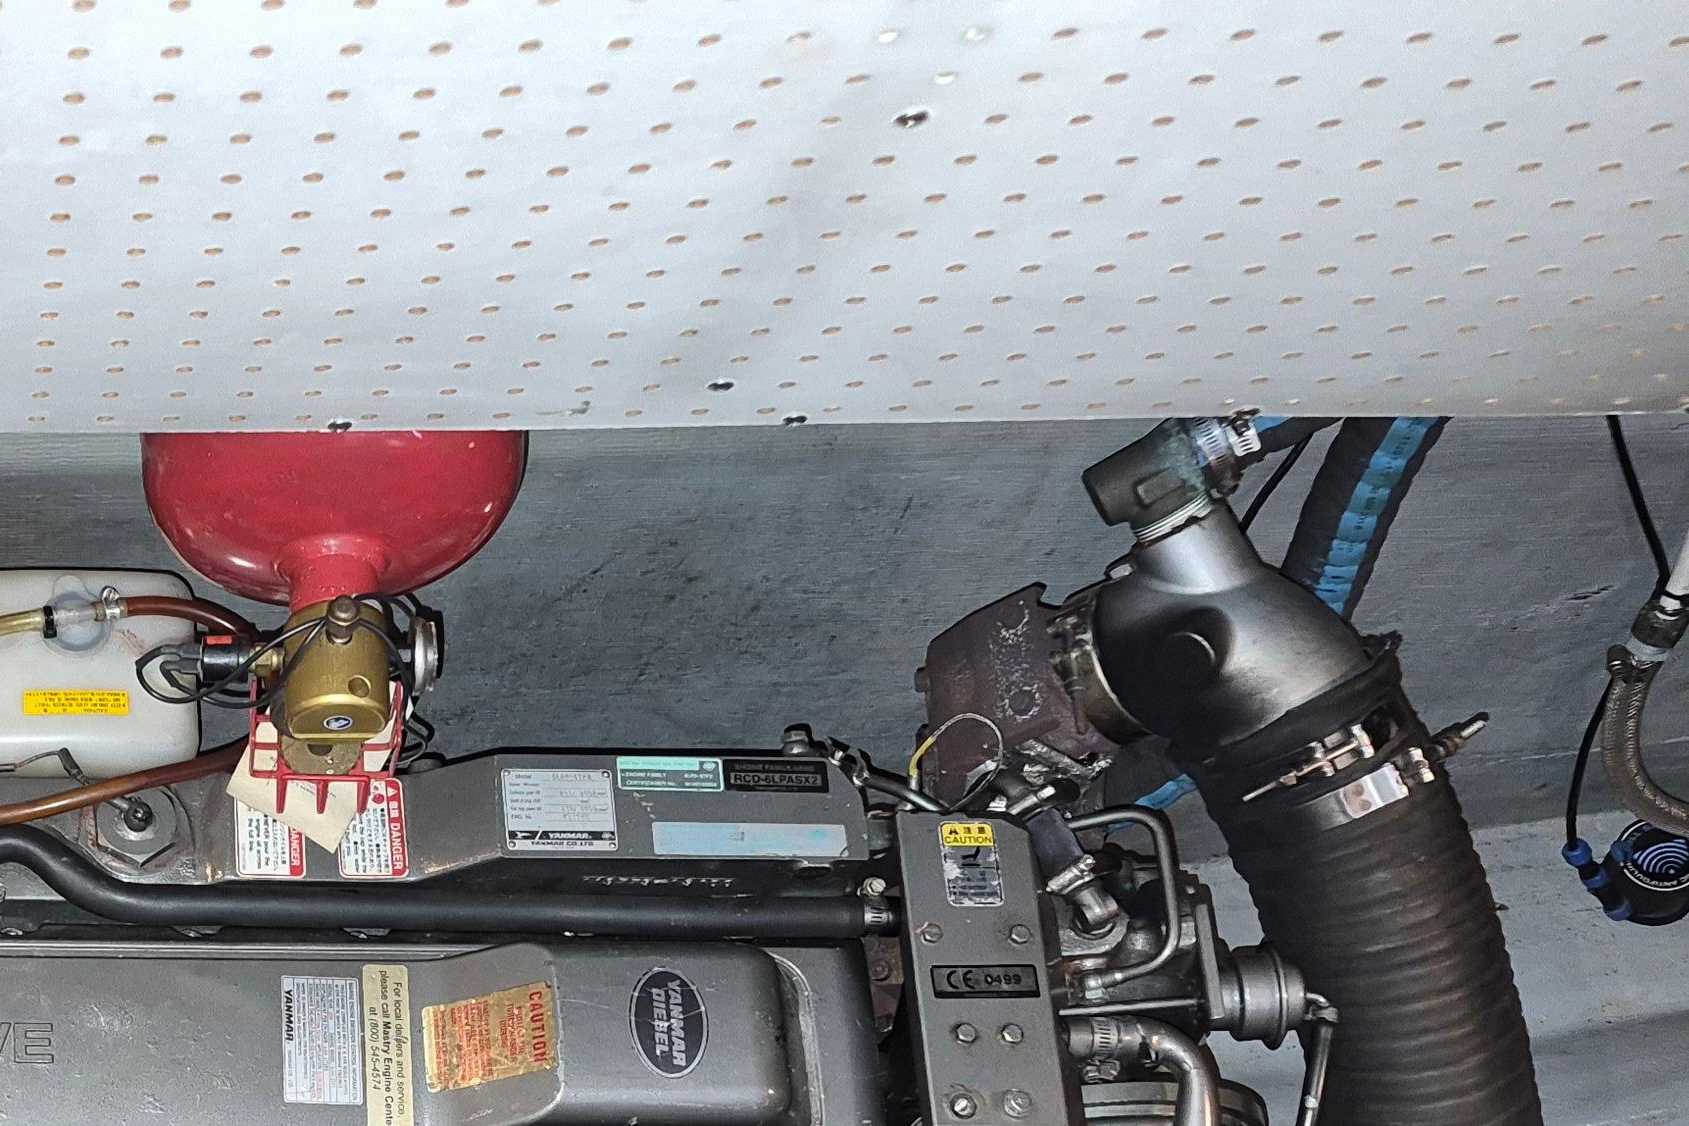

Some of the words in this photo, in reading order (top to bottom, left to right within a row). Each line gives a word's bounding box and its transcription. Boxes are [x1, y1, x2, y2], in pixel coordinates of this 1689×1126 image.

[733, 773, 819, 785] RCD-6LPASX2
[390, 822, 403, 870] DANGER
[944, 836, 992, 845] CAUTION
[379, 970, 390, 1000] please
[393, 982, 402, 997] For
[946, 969, 975, 989] CE
[284, 989, 294, 1042] YANMAR
[368, 1006, 377, 1016] at
[381, 1002, 391, 1019] call
[393, 999, 403, 1021] local
[651, 987, 669, 1056] DIESEL
[667, 979, 686, 1067] YANMAR
[368, 1018, 380, 1042] (800)
[381, 1021, 392, 1055] Mastry
[529, 991, 548, 1063] CAUTION
[370, 1045, 381, 1090] 545-4574
[382, 1057, 393, 1093] Engine
[396, 1060, 406, 1078] and
